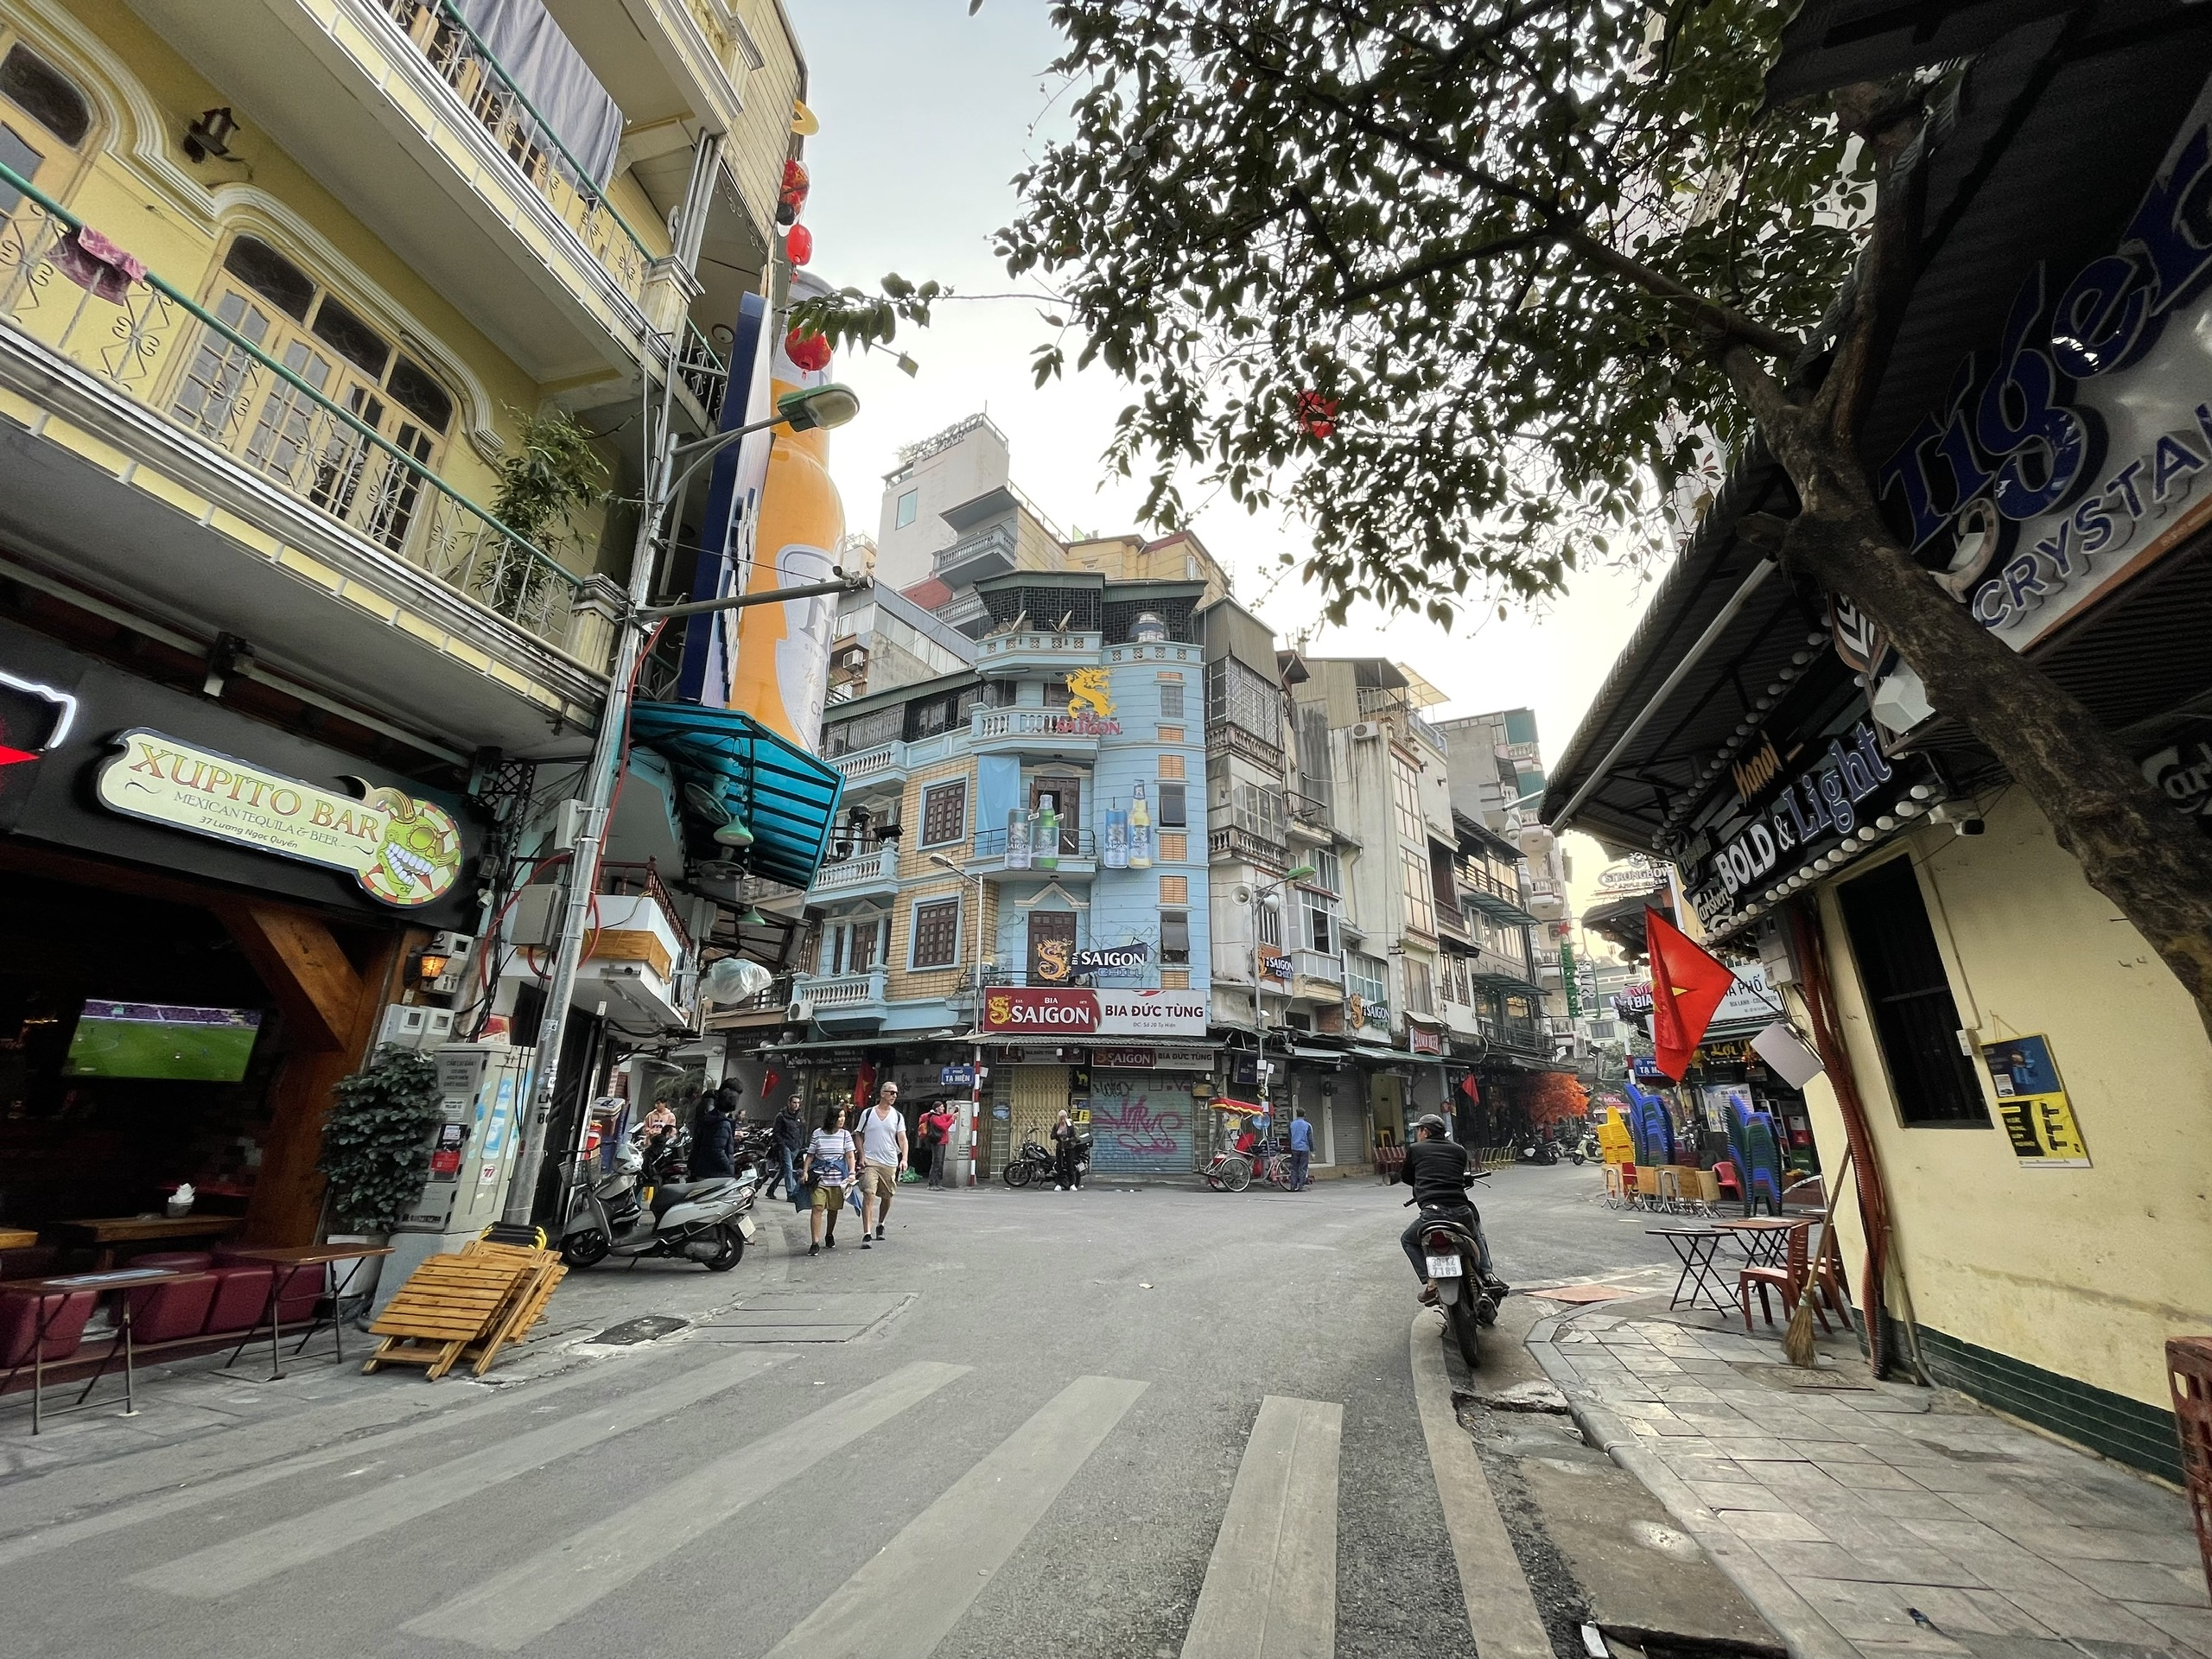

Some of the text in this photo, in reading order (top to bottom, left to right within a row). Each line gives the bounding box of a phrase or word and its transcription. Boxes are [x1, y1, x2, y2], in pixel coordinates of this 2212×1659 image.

[943, 432, 964, 448] BAR
[1782, 721, 1892, 844] Light
[129, 742, 378, 842] XUPITO BAR
[173, 791, 339, 847] MEXICAN TEQUILA & BEER
[199, 816, 213, 825] 37
[1774, 815, 1796, 851] &
[1714, 823, 1777, 896] BOLD
[1692, 884, 1735, 929] Carlsberg
[1081, 951, 1145, 966] SAIGON
[1269, 957, 1294, 971] SAIGON
[1097, 968, 1143, 977] CHILL
[1633, 994, 1654, 1008] BIA
[1011, 1005, 1090, 1024] SAIGON
[1105, 1002, 1204, 1018] BIA ĐỨC TÙNG
[1366, 1005, 1390, 1020] SAIGON
[1107, 1052, 1150, 1064] SAIGON
[955, 1073, 969, 1083] HIỆN
[1638, 1066, 1650, 1075] TẠ
